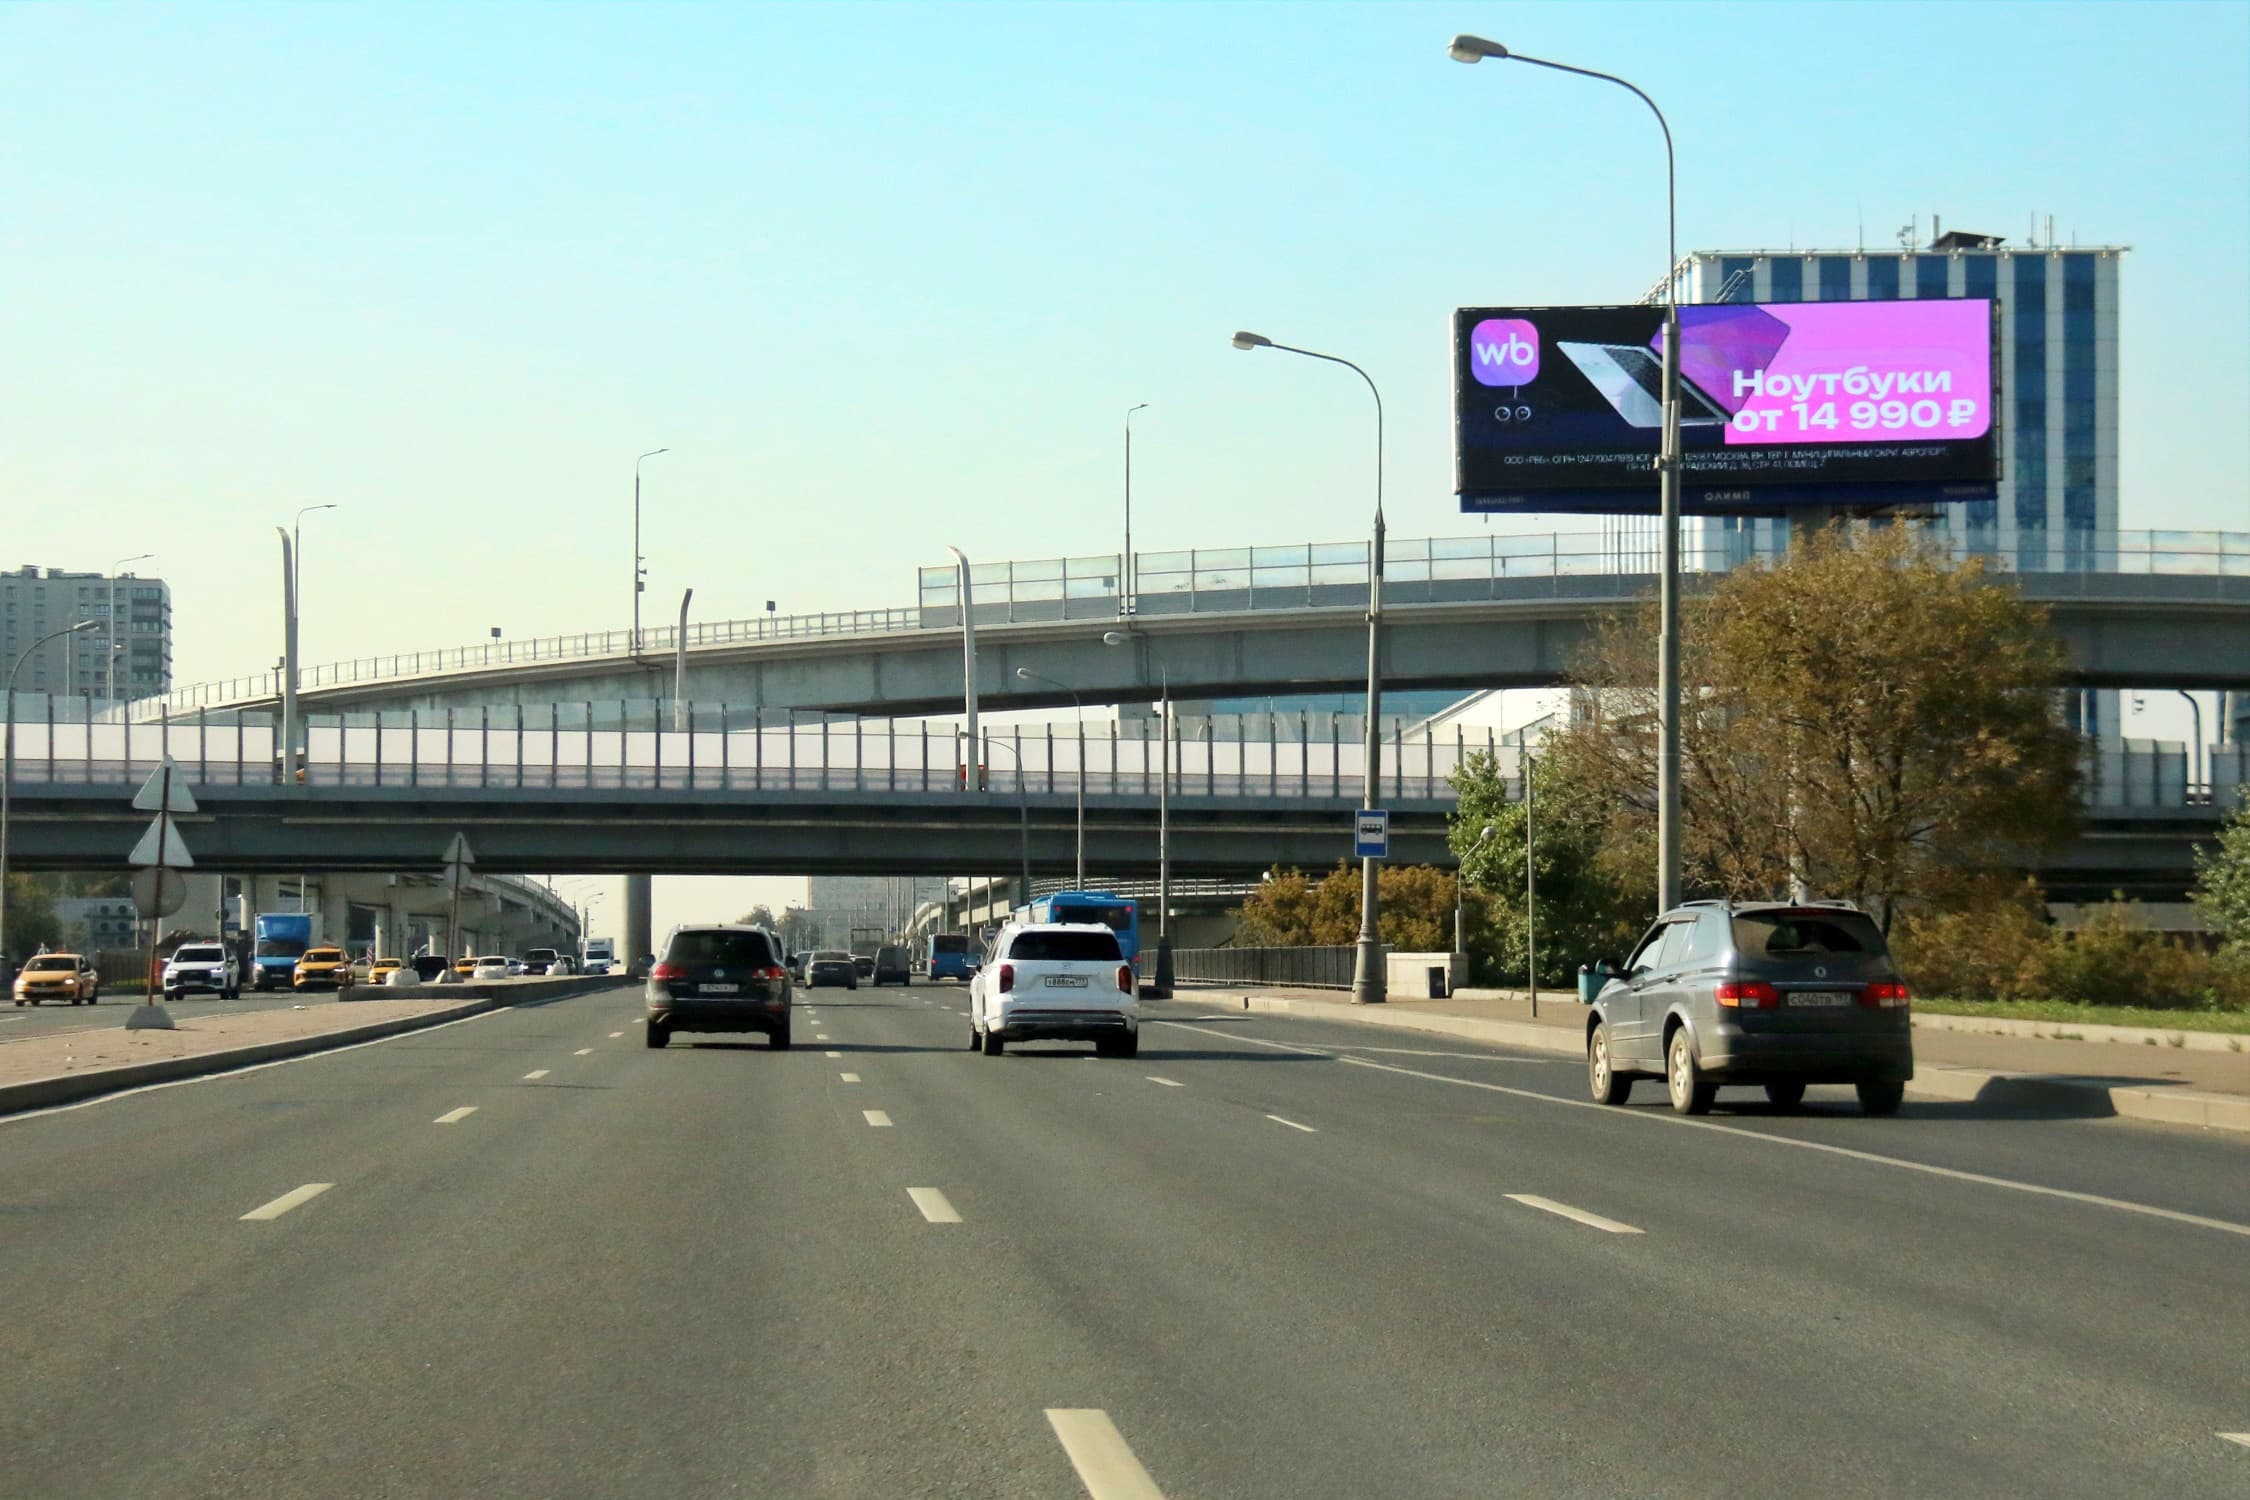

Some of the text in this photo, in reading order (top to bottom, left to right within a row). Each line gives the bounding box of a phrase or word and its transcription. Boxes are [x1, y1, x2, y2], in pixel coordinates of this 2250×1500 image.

[1475, 332, 1534, 366] wb
[1733, 366, 1952, 401] Ноутбуки
[1733, 409, 1783, 432] от
[1791, 402, 1839, 431] 14
[1704, 491, 1751, 501] ОЛИМП
